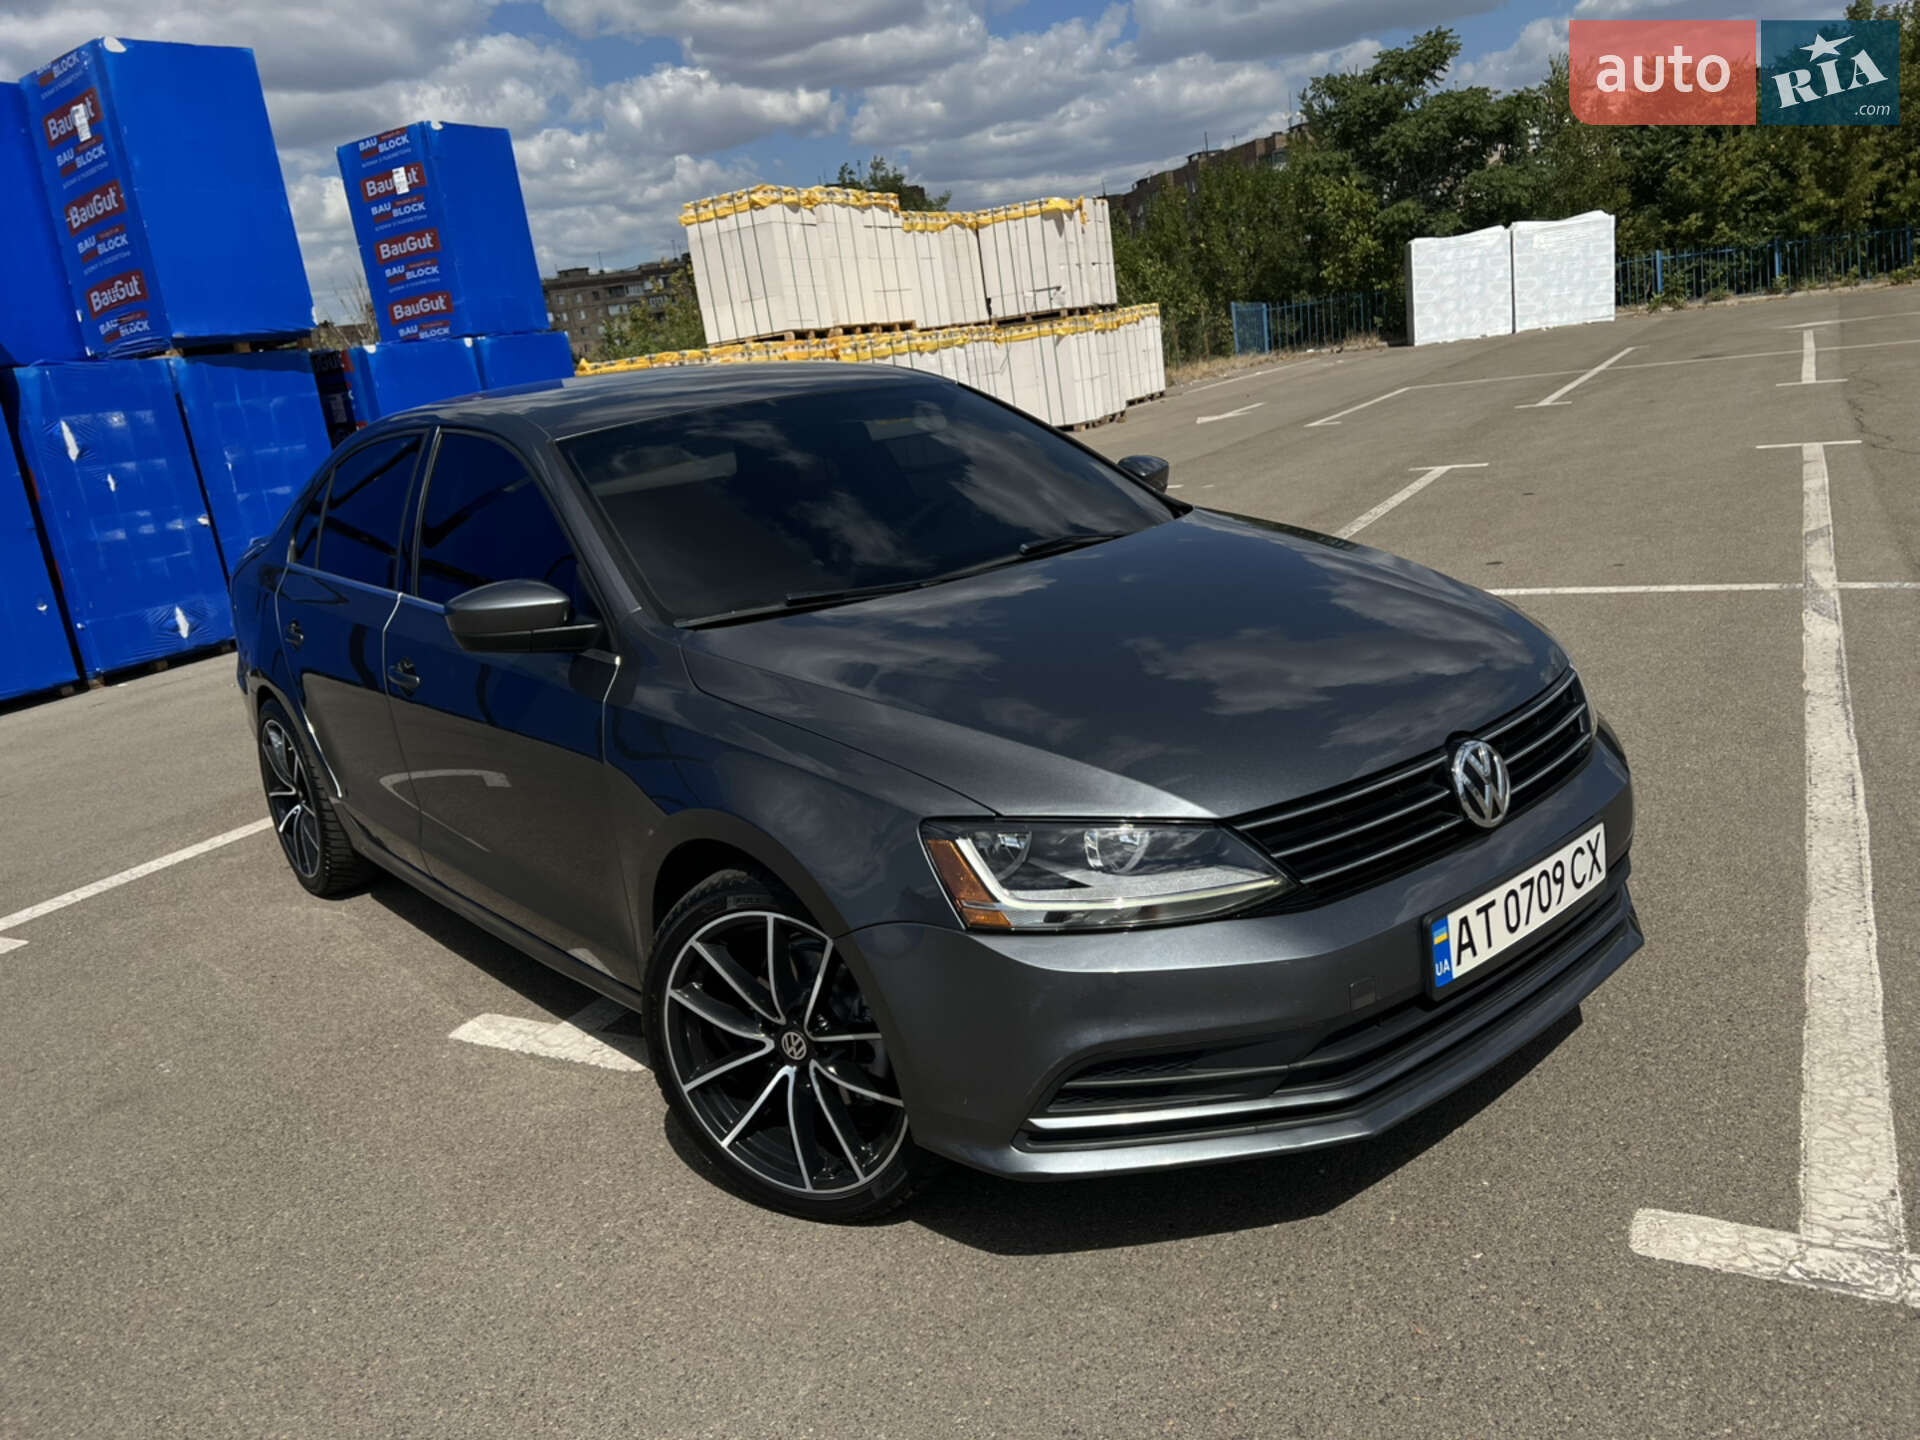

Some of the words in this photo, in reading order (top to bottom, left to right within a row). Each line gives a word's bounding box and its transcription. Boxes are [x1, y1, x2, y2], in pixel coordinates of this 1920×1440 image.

[55, 147, 75, 167] BAU
[75, 143, 107, 168] BLOCK
[358, 137, 377, 151] BAU
[378, 134, 410, 153] BLOCK
[366, 167, 419, 197] Bauut
[69, 187, 119, 229] BauGut
[371, 201, 391, 216] BAU
[392, 201, 426, 218] BLOCK
[77, 235, 96, 254] BAU
[97, 233, 128, 255] BLOCK
[379, 232, 434, 260] BauGut
[384, 264, 405, 278] BAU
[405, 265, 440, 280] BLOCK
[90, 275, 142, 313] BauGut
[392, 295, 447, 321] BauGut
[398, 324, 418, 337] BAU
[419, 326, 450, 339] BLOCK
[1456, 899, 1496, 966] AT
[1503, 860, 1565, 934] 0709
[1571, 831, 1602, 889] CX
[1435, 957, 1450, 976] UA
